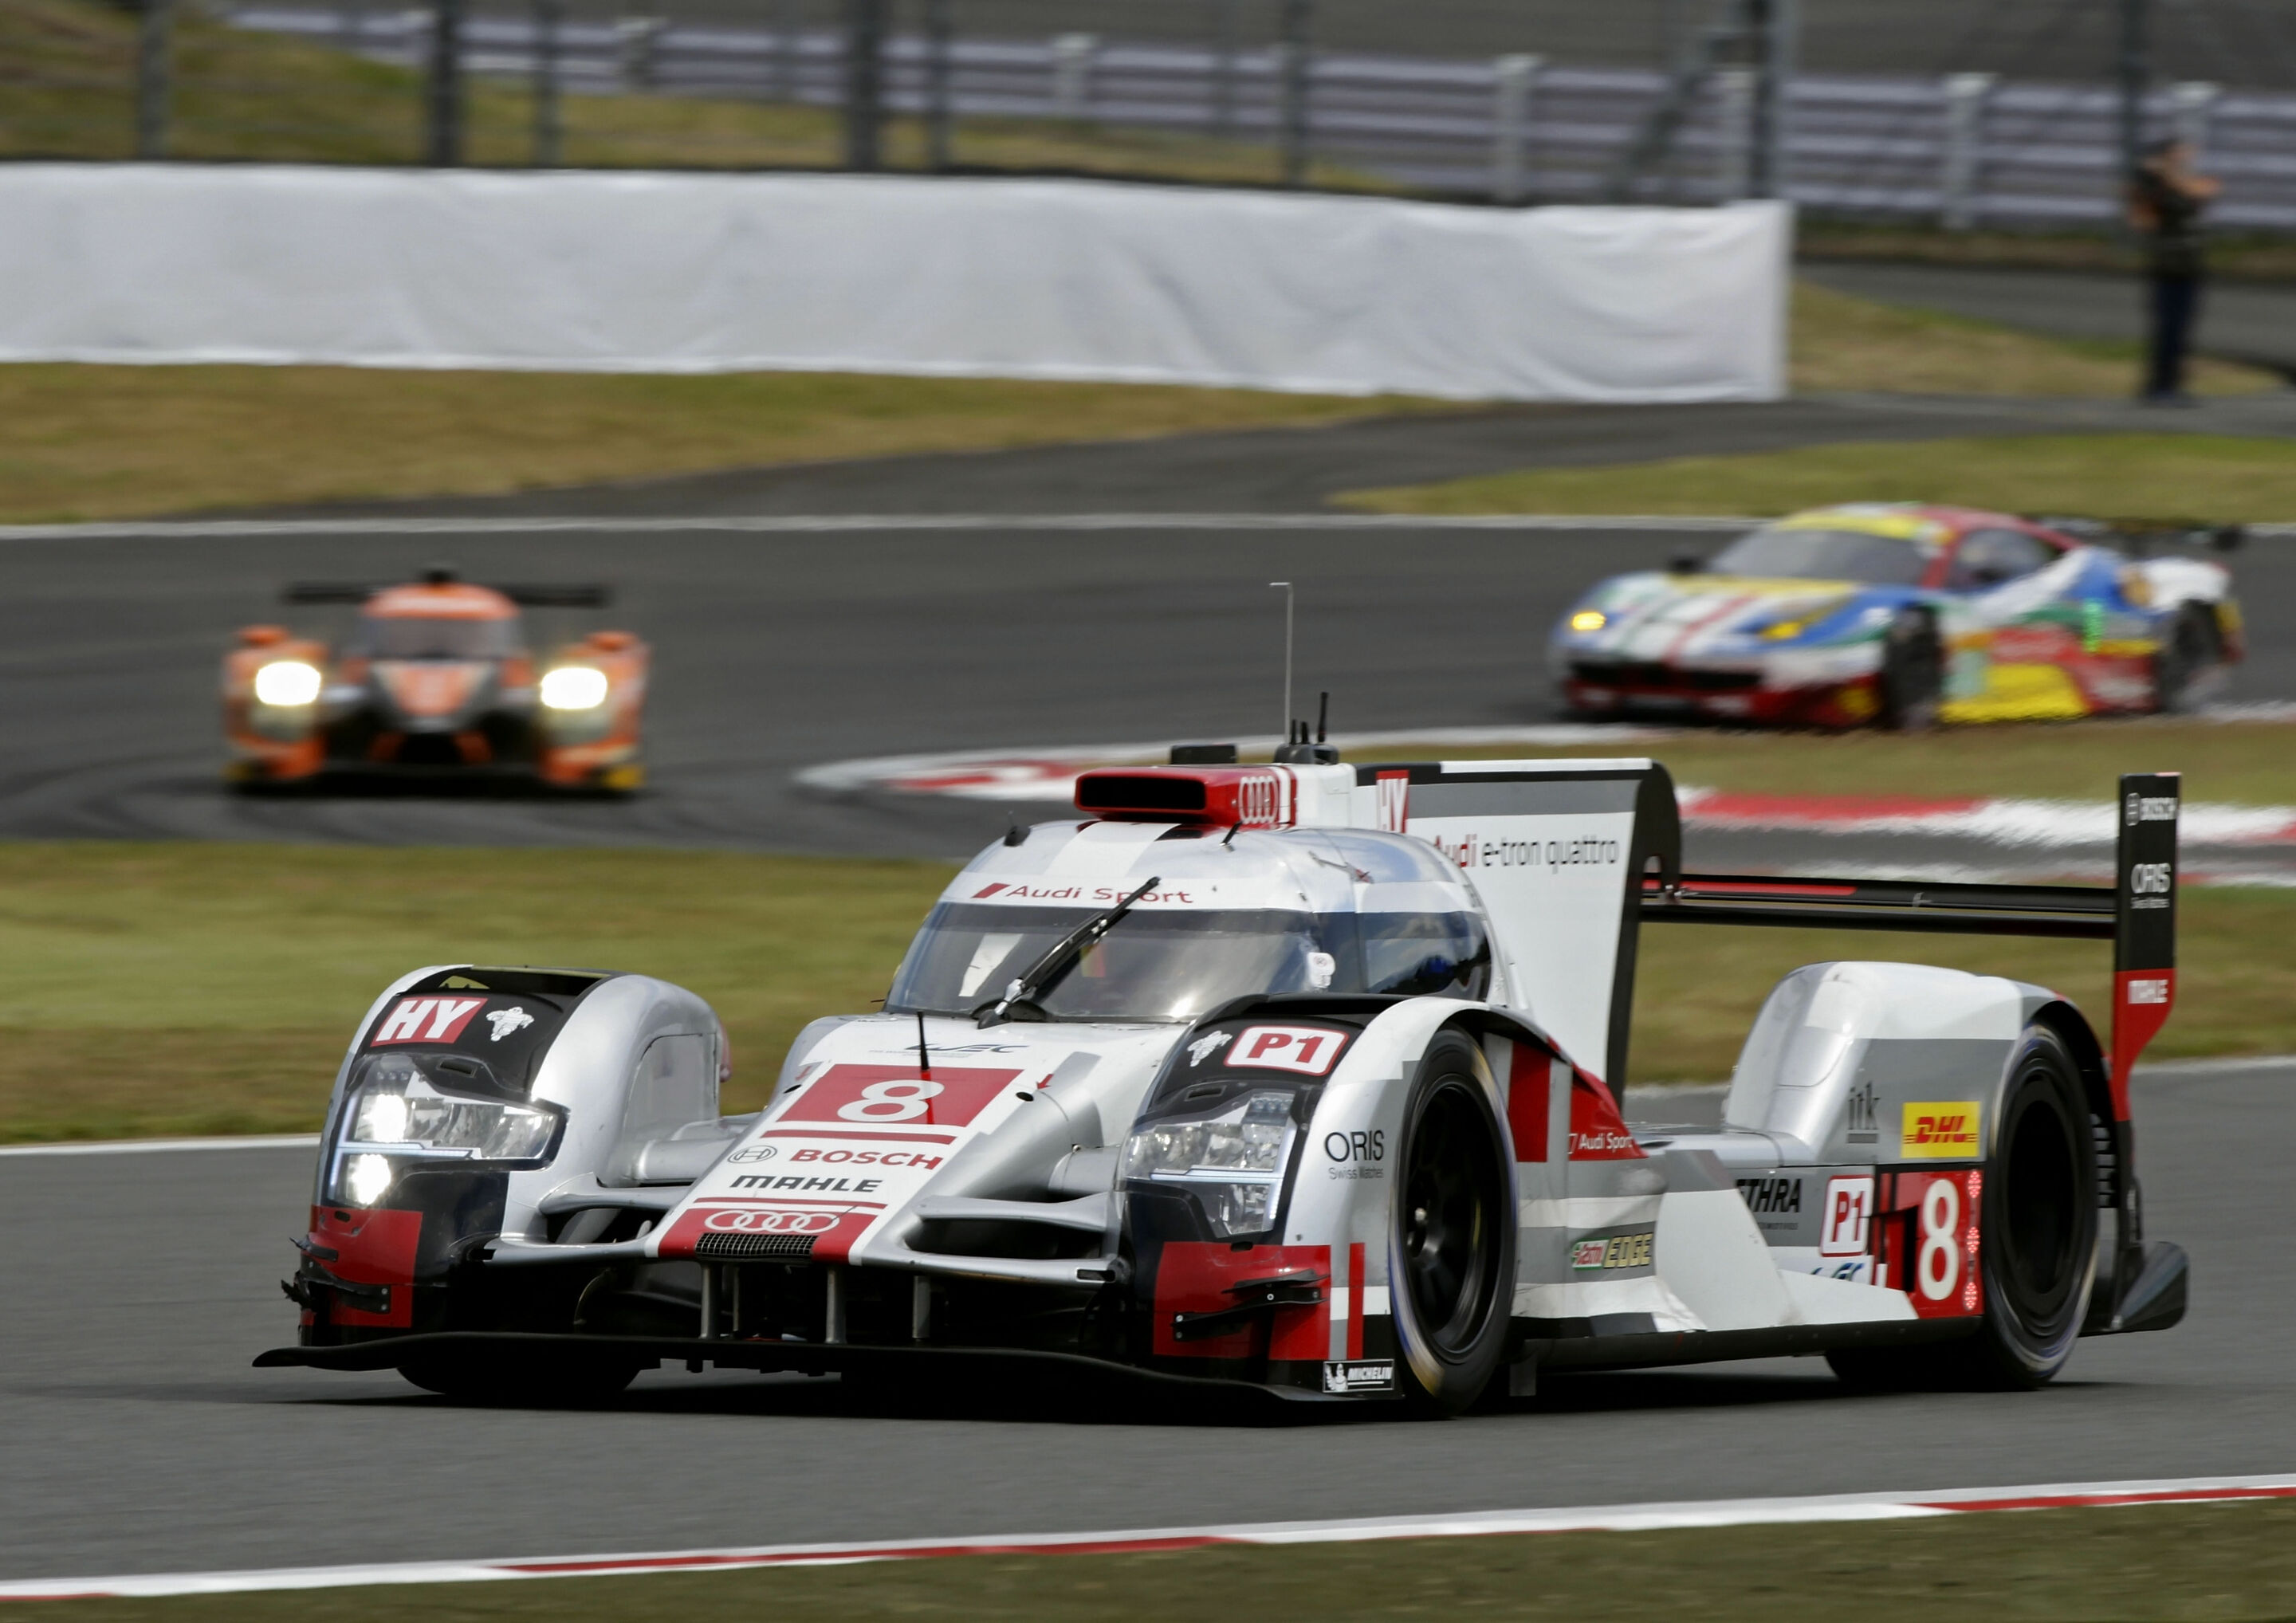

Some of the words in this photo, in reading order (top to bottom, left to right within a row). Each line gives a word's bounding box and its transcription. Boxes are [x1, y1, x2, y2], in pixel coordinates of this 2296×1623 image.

[1481, 837, 1541, 867] e-tron
[1546, 835, 1619, 874] quattro
[1005, 885, 1082, 898] Audi
[1093, 887, 1193, 903] Sport
[375, 999, 481, 1042] HY
[1246, 1032, 1324, 1063] P1
[837, 1079, 946, 1123] 8
[1324, 1129, 1385, 1163] ORIS
[1578, 1132, 1604, 1149] Audi
[1916, 1115, 1967, 1144] DHL
[789, 1149, 945, 1170] BOSCH
[729, 1175, 883, 1193] MAHLE
[1830, 1190, 1866, 1243] P1
[1603, 1232, 1654, 1268] EDGE
[1918, 1178, 1960, 1301] 8
